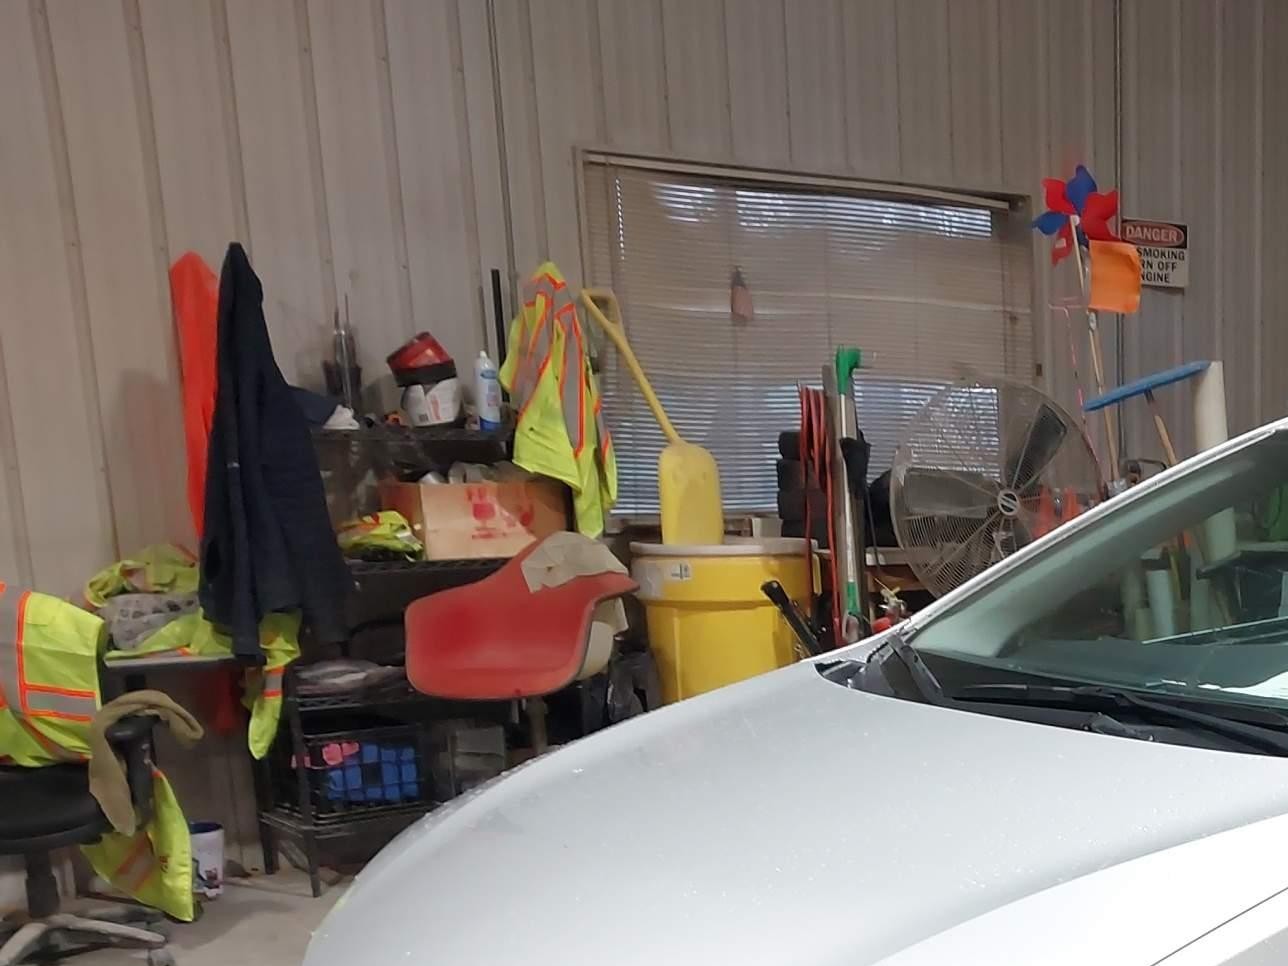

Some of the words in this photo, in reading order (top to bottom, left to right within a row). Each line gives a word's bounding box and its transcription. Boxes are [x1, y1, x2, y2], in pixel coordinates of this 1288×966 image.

[1126, 226, 1177, 242] DANGER
[1136, 247, 1185, 261] SMOKING
[1157, 261, 1177, 272] OFF
[1140, 271, 1170, 284] NGINE
